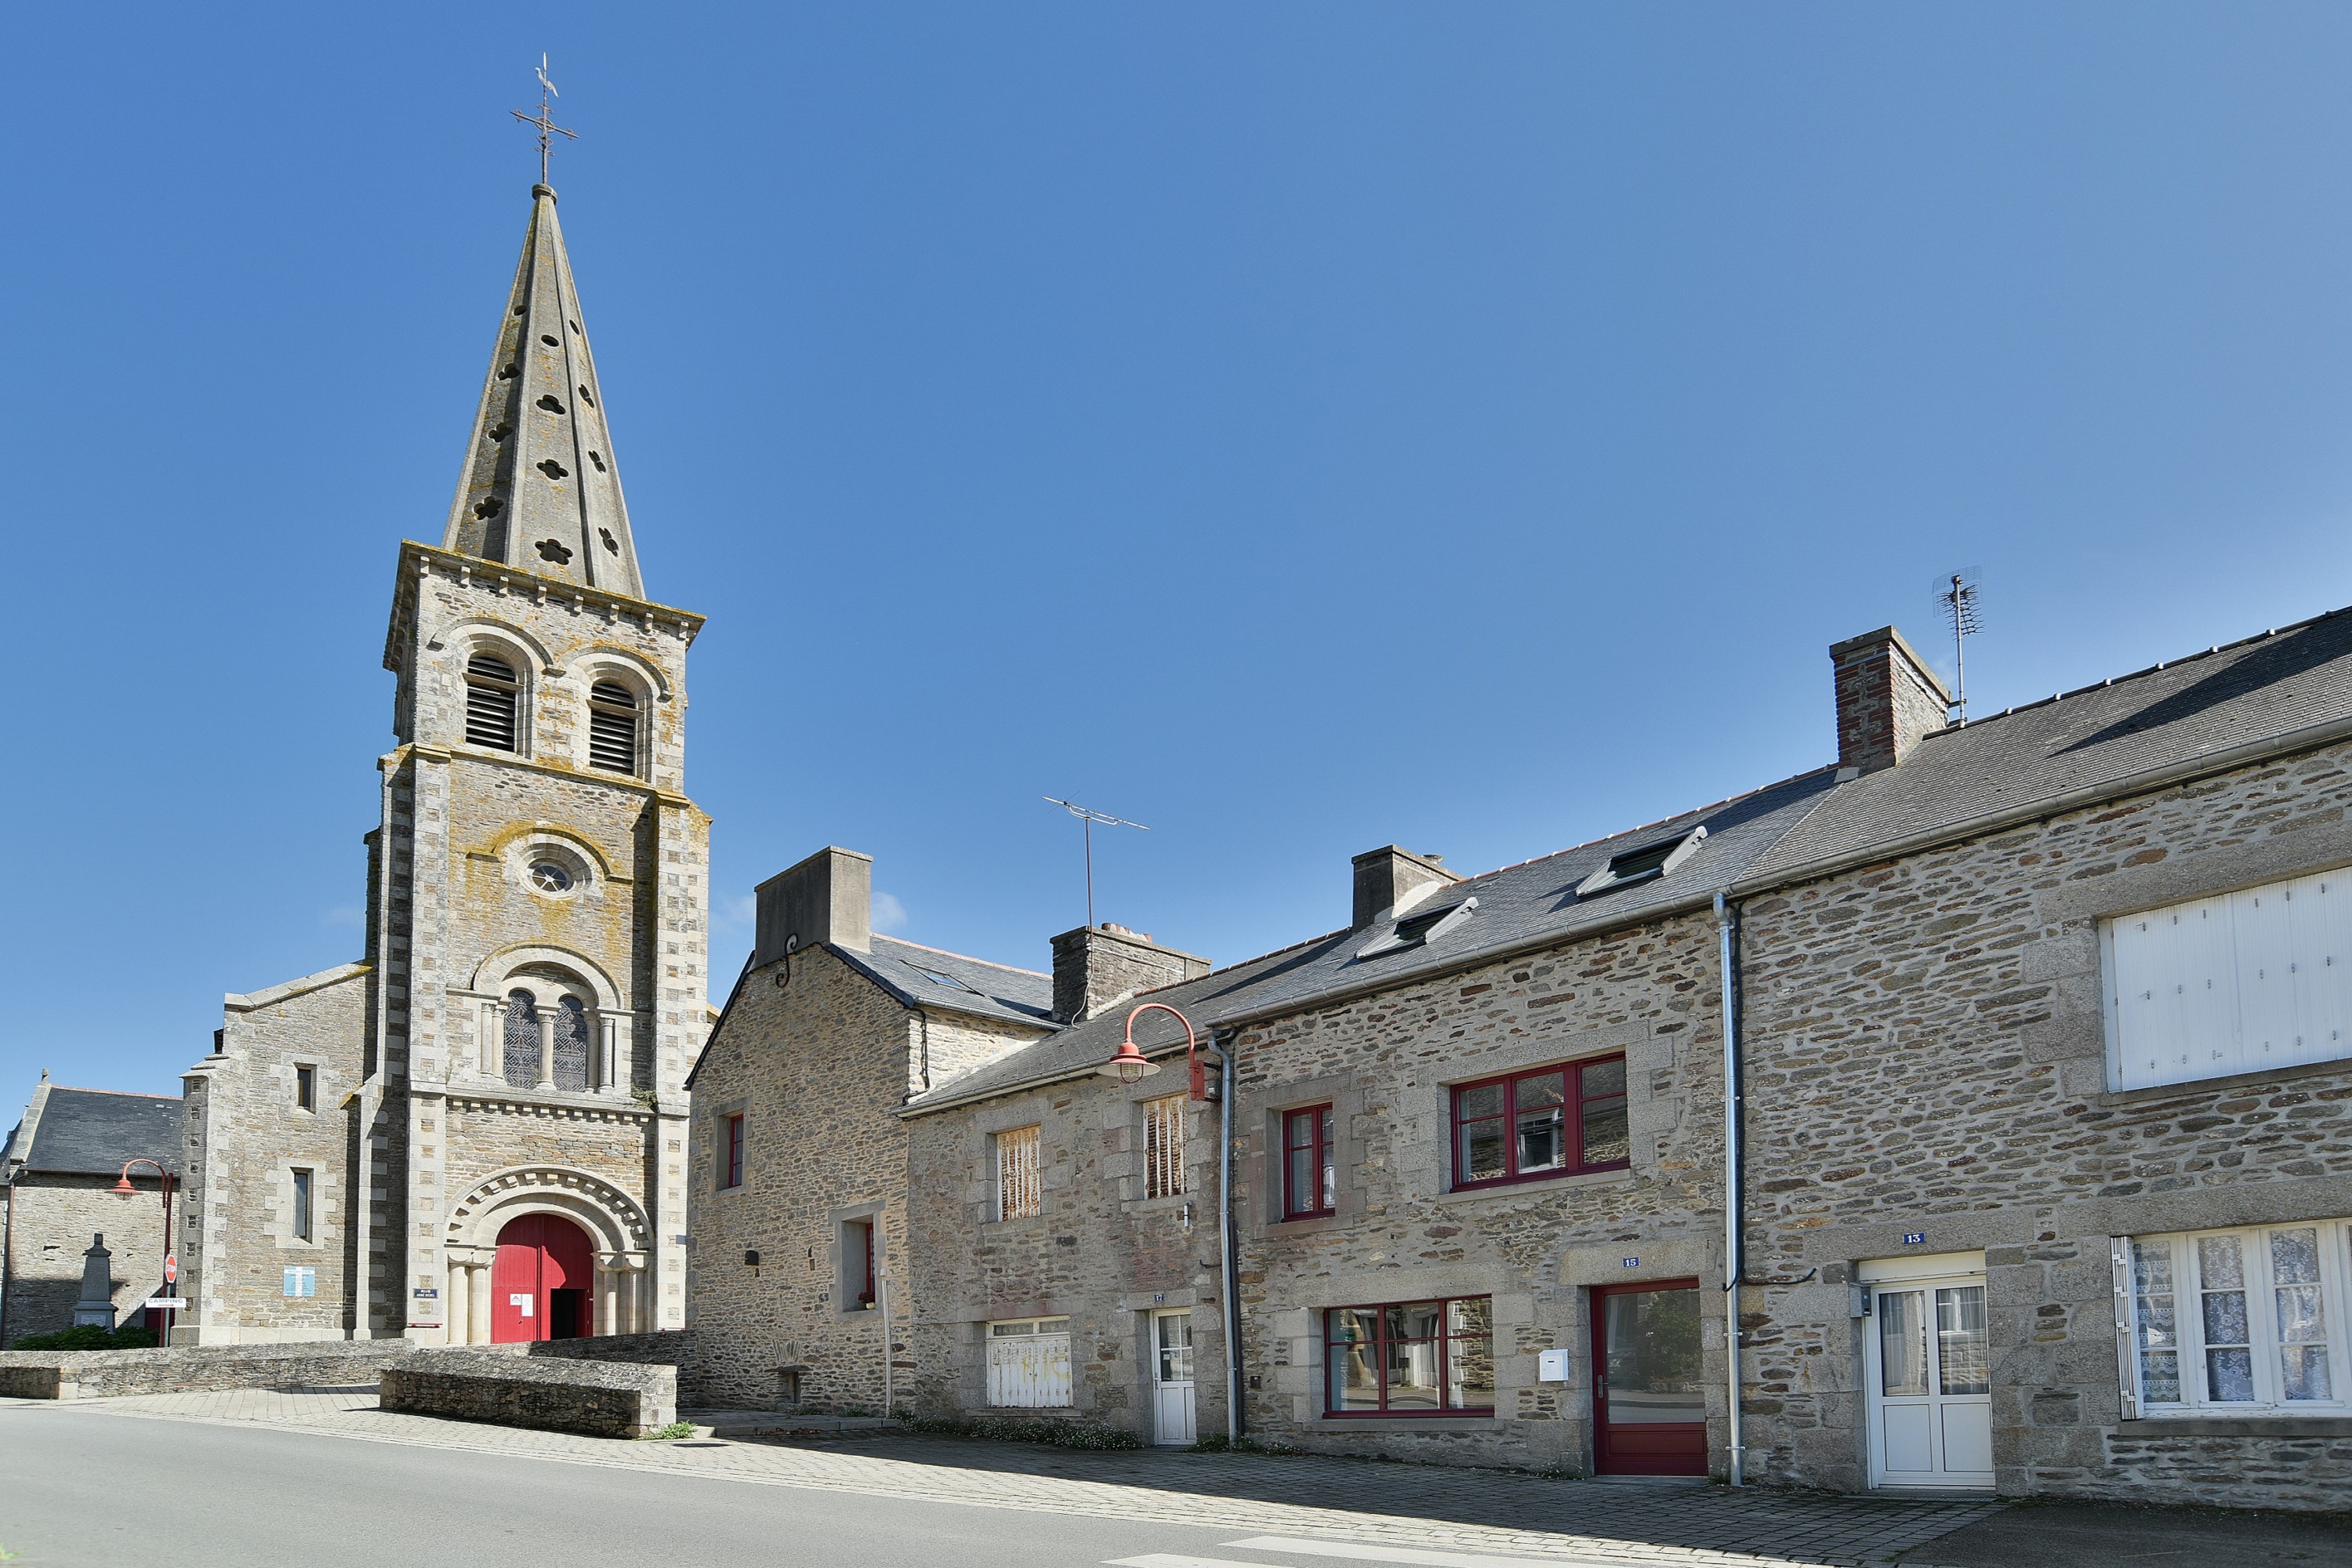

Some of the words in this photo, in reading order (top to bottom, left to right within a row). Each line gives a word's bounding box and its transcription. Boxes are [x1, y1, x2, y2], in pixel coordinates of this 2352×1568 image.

[1907, 1234, 1921, 1243] 13
[1625, 1258, 1636, 1267] 15
[166, 1264, 176, 1273] STOP
